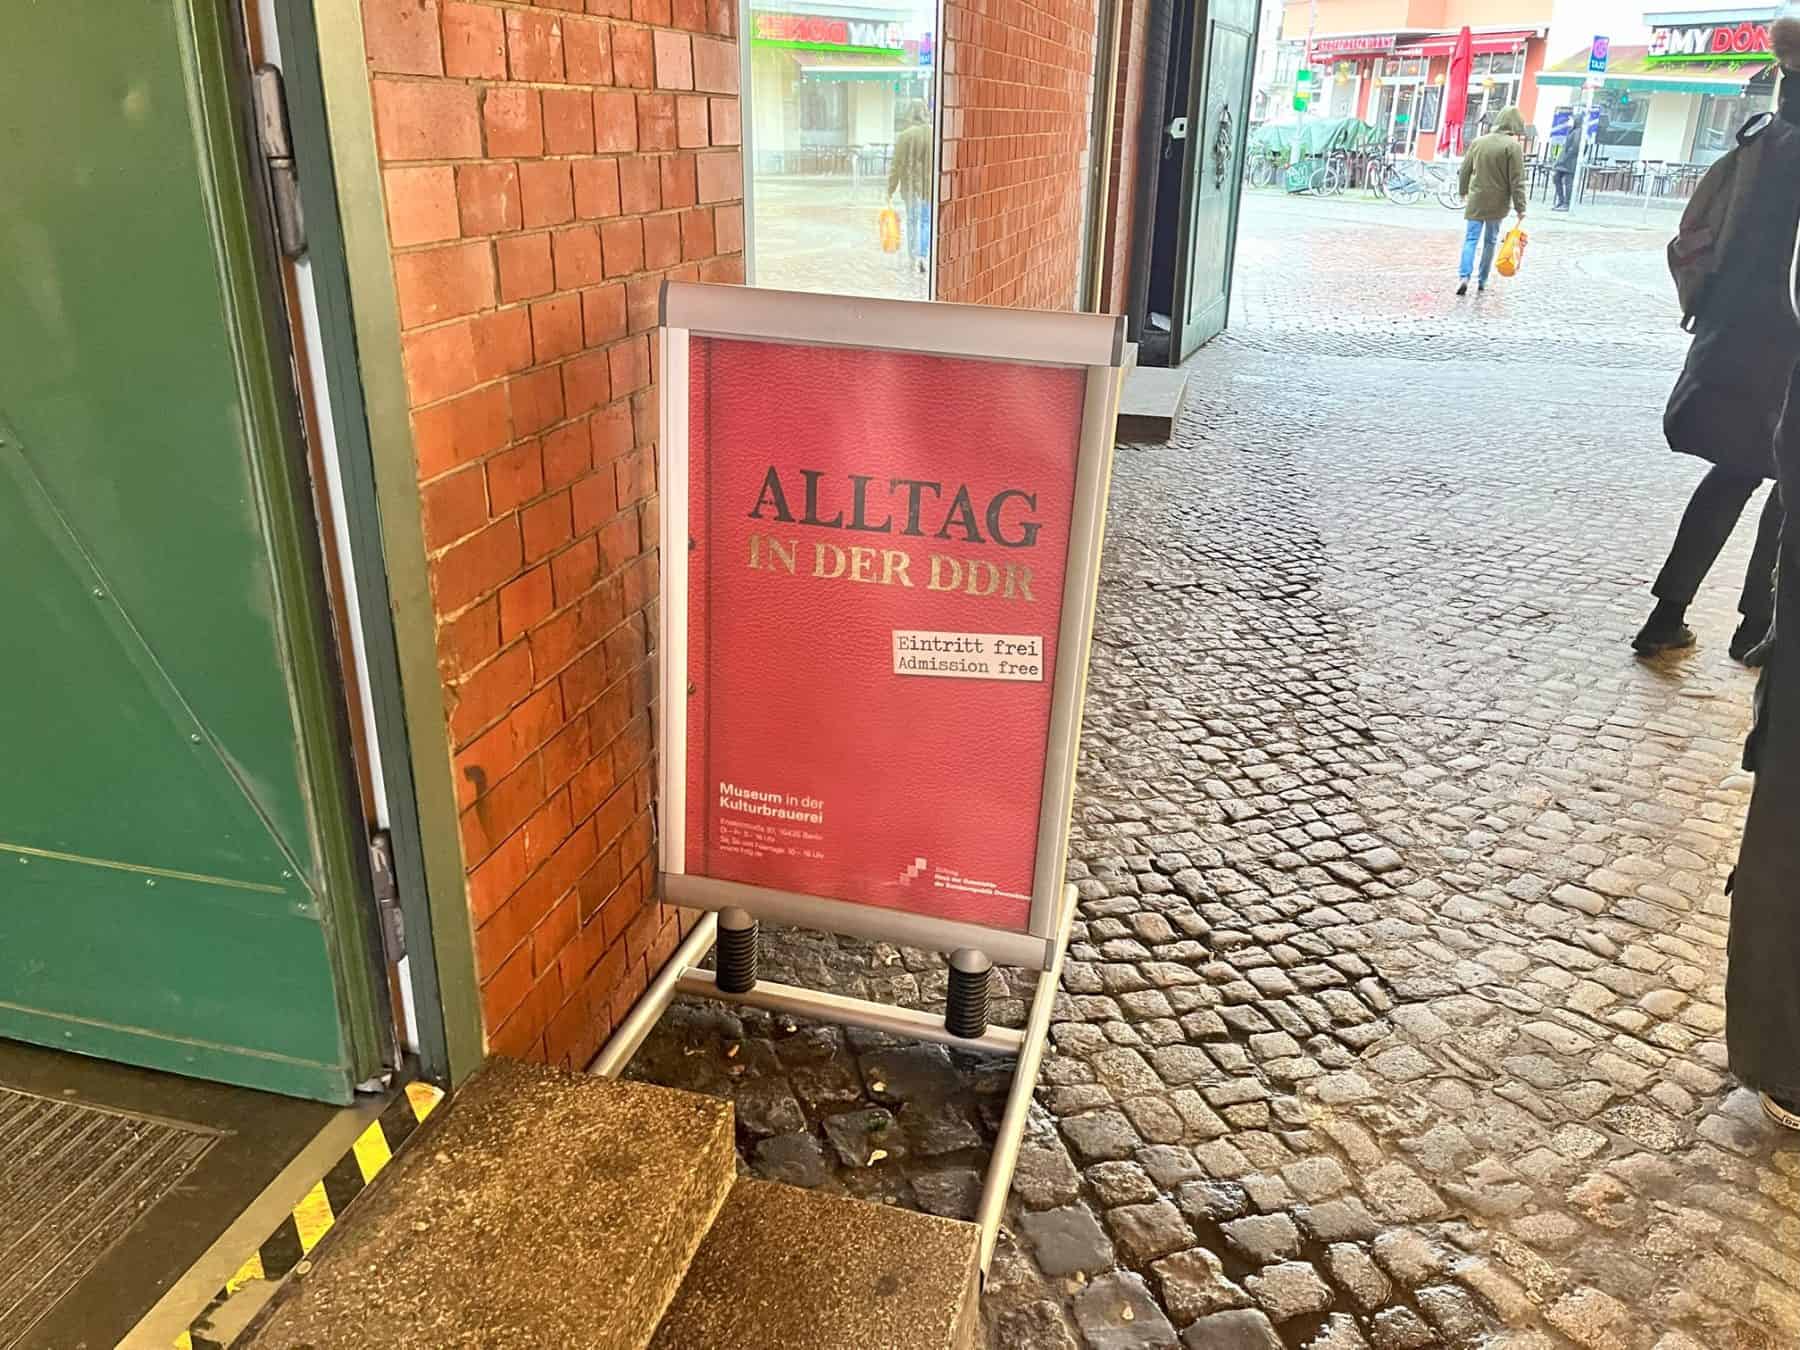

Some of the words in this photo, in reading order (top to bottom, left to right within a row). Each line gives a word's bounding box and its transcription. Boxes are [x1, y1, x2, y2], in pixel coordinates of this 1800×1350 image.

[748, 465, 1042, 548] ALLTAG
[747, 533, 799, 575] IN
[811, 542, 914, 588] DER
[926, 554, 1037, 602] DDR
[897, 635, 984, 654] Eintritt
[993, 640, 1038, 657] frei
[898, 655, 989, 674] Admission
[998, 660, 1039, 676] free
[719, 781, 782, 805] Museum
[785, 792, 799, 807] in
[801, 795, 824, 810] der
[719, 796, 823, 825] Kulturbrauerei
